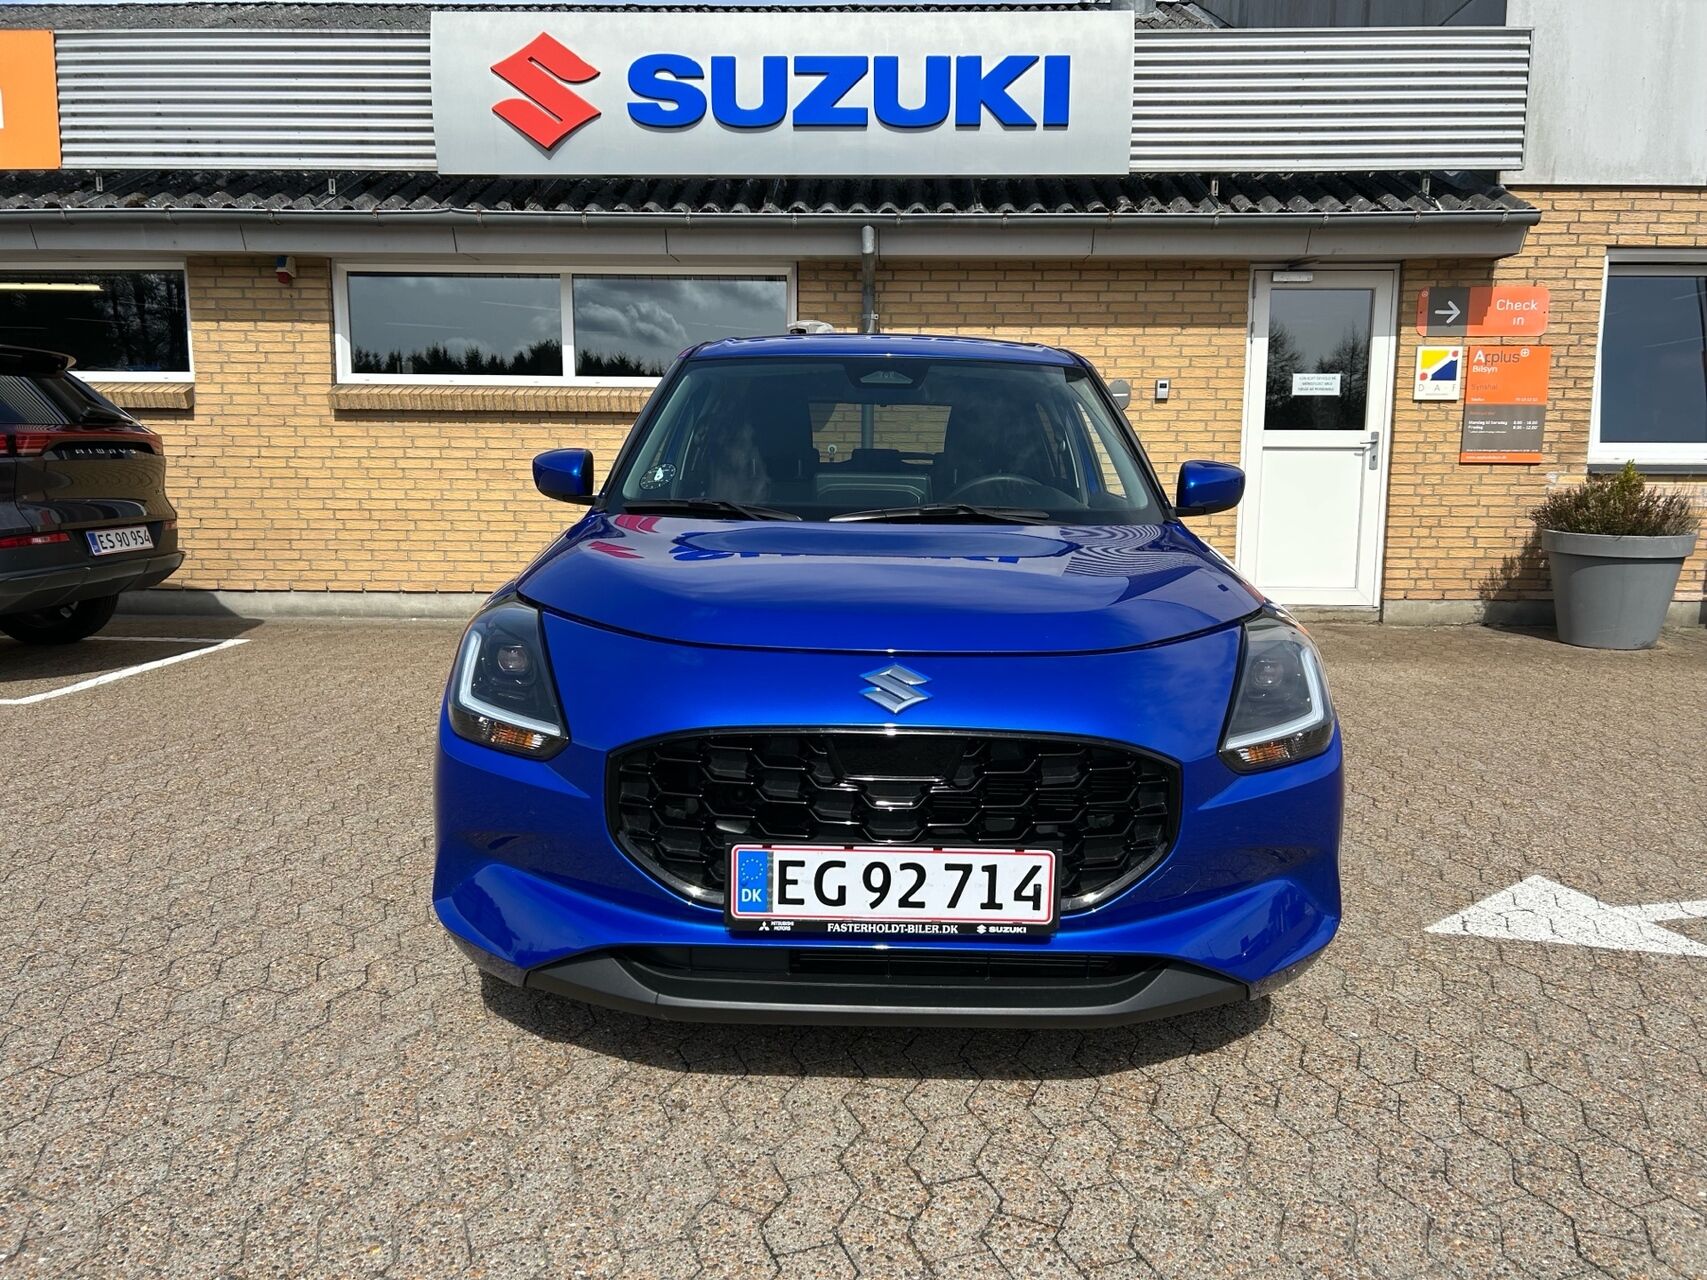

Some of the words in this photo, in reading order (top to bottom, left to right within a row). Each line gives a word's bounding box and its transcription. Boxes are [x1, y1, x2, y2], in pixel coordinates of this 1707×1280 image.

[627, 53, 1070, 128] SUZUKI
[1496, 299, 1538, 311] Check
[1512, 316, 1525, 326] in
[1472, 366, 1498, 374] Bilsyn
[97, 532, 115, 550] ES
[115, 531, 130, 547] 90
[130, 529, 151, 545] 954
[777, 859, 847, 907] EG
[862, 861, 927, 910] 92
[944, 863, 1043, 911] 714
[741, 888, 762, 903] DK
[827, 922, 959, 935] FASTERHOLDT-BILER.DK
[988, 926, 1027, 934] SUZUKI
